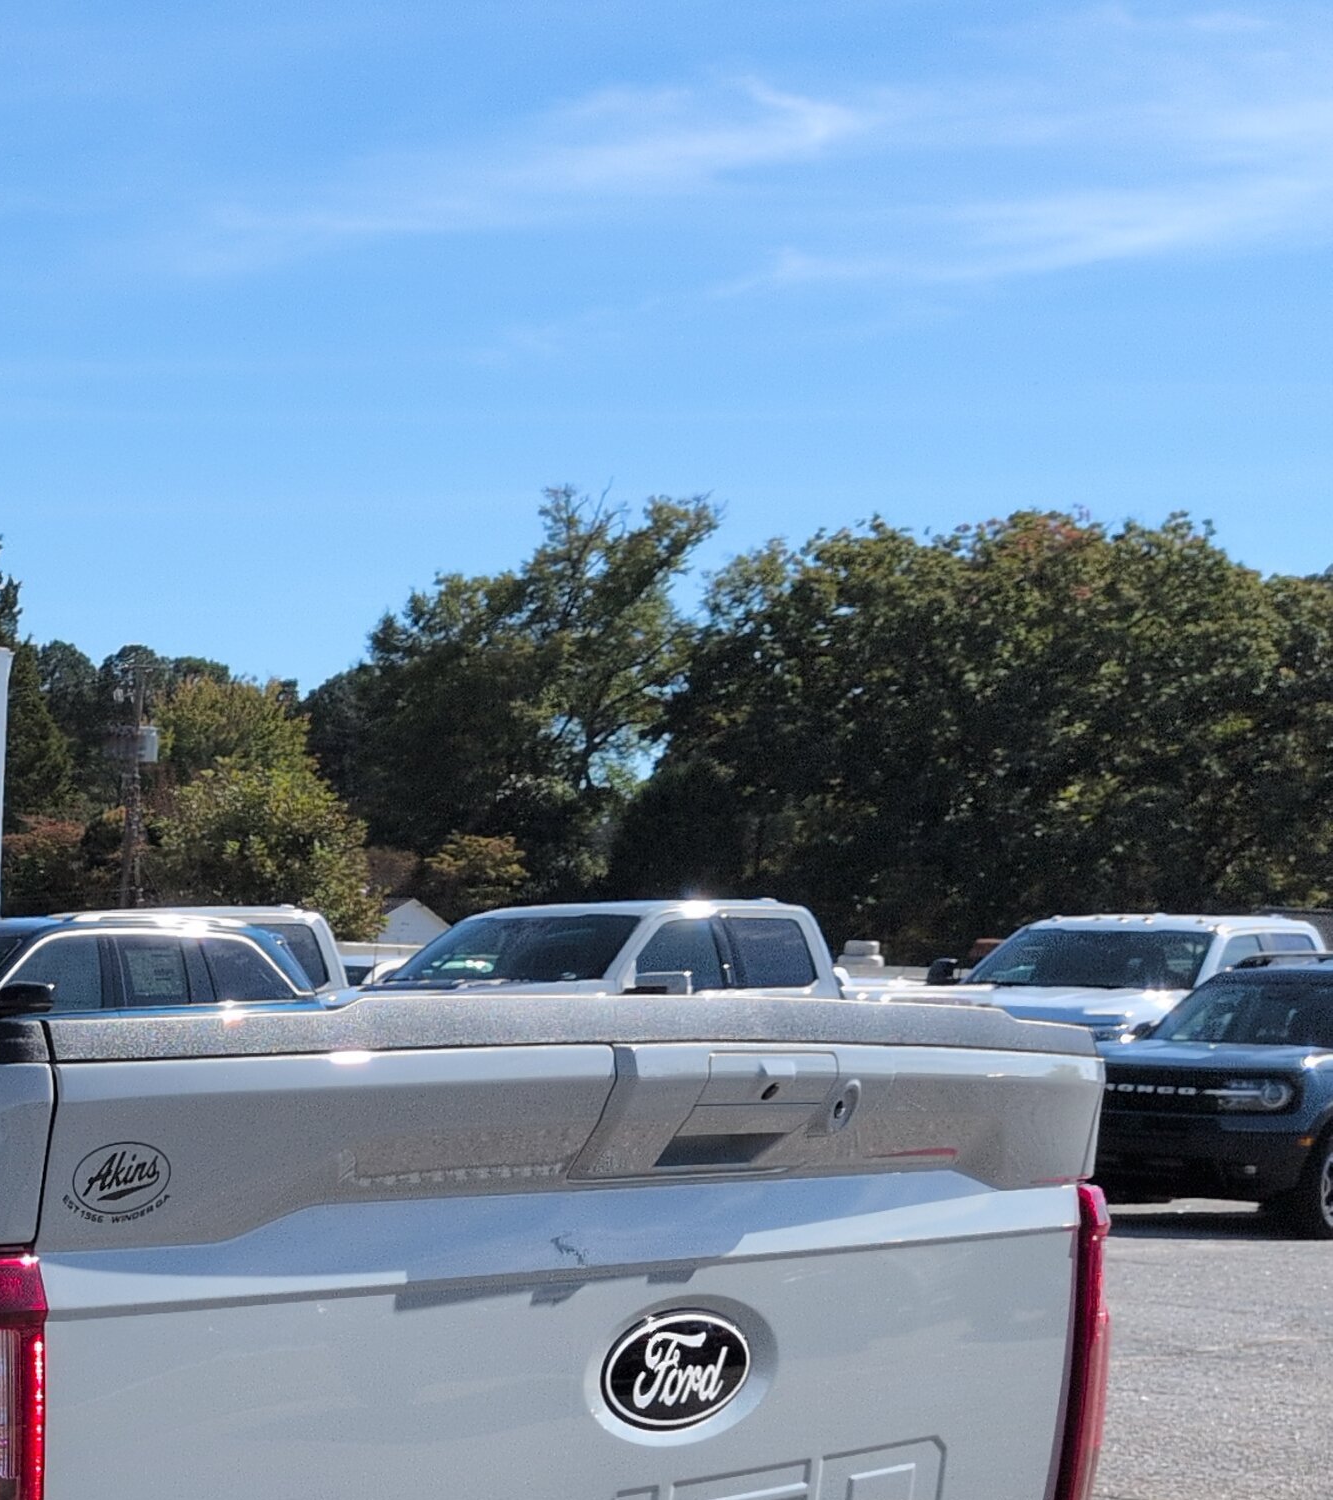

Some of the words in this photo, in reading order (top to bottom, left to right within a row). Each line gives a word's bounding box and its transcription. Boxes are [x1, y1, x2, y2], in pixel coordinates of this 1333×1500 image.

[82, 1150, 160, 1198] Akins
[62, 1194, 80, 1214] EST
[111, 1205, 154, 1224] WINDER
[155, 1194, 171, 1209] GA
[632, 1331, 728, 1409] Ford
